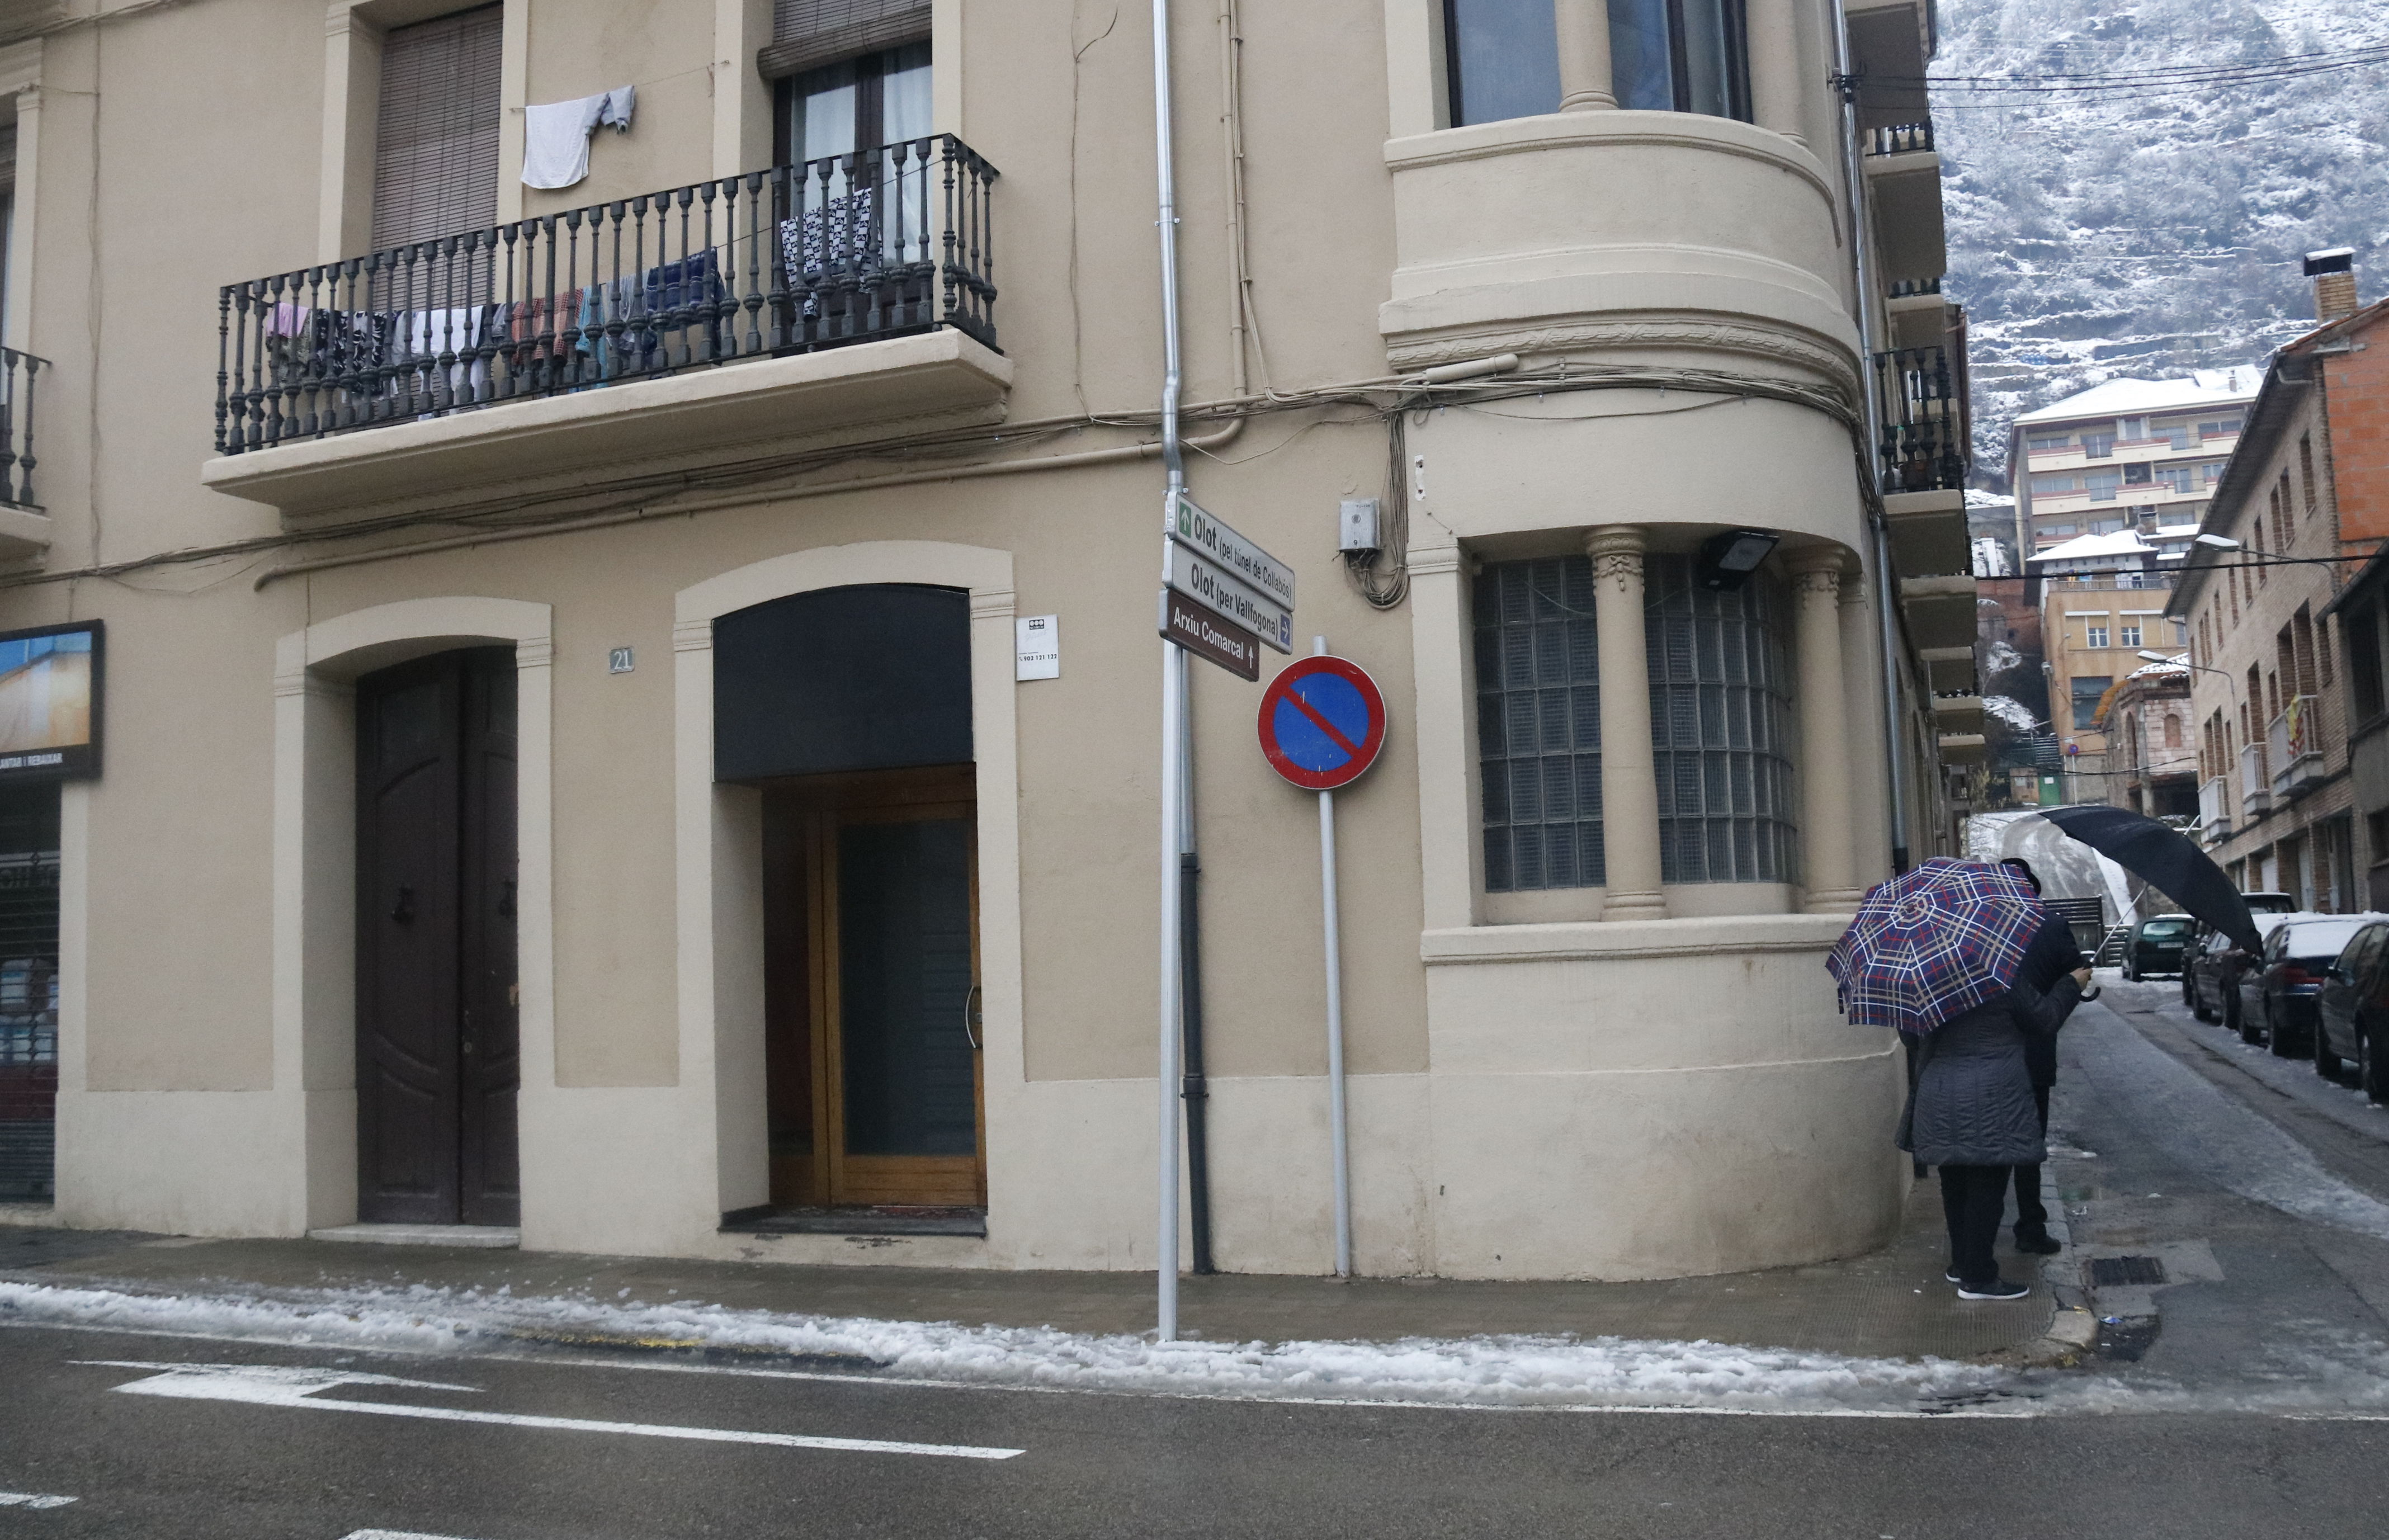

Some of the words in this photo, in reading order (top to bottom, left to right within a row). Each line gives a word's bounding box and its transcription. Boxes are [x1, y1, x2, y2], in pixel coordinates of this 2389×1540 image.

[1194, 513, 1216, 551] Olot
[1219, 536, 1233, 561] (pel
[1235, 548, 1251, 573] túnel
[1253, 560, 1261, 579] de
[1263, 566, 1291, 603] Collabós)
[1173, 606, 1200, 637] Arxiu
[1202, 621, 1243, 660] Comarcal
[1191, 563, 1214, 600] Olot
[1216, 583, 1233, 610] (per
[1235, 593, 1278, 642] Vallfogona)
[613, 650, 630, 670] 21
